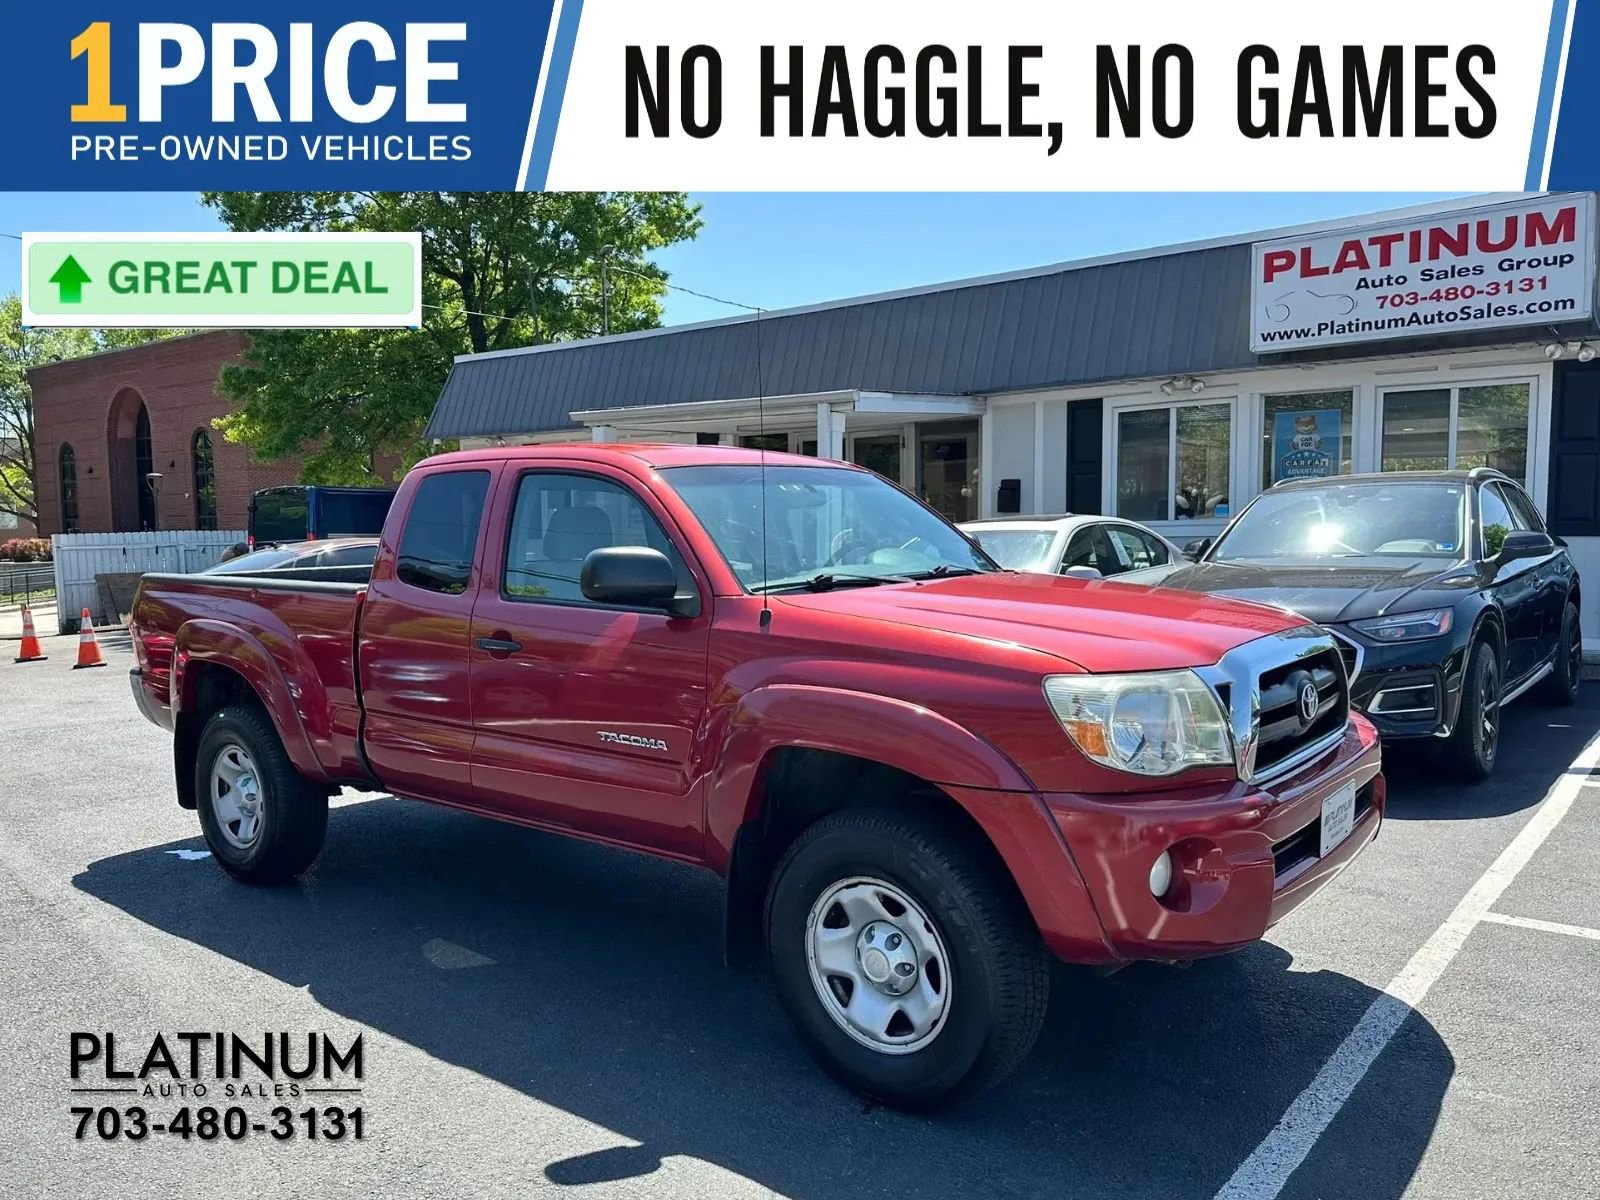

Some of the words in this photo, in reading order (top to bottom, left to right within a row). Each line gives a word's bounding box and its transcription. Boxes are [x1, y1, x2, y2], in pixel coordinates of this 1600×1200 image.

[1263, 207, 1577, 283] PLATINUM
[1355, 273, 1408, 291] Auto
[1419, 262, 1485, 282] Sales
[1497, 252, 1575, 273] Group
[1376, 276, 1548, 309] 703-480-3131
[1261, 297, 1576, 342] www.PlatinumAutoSales.com
[1285, 458, 1329, 467] CARFAX
[596, 731, 668, 751] TACOMA
